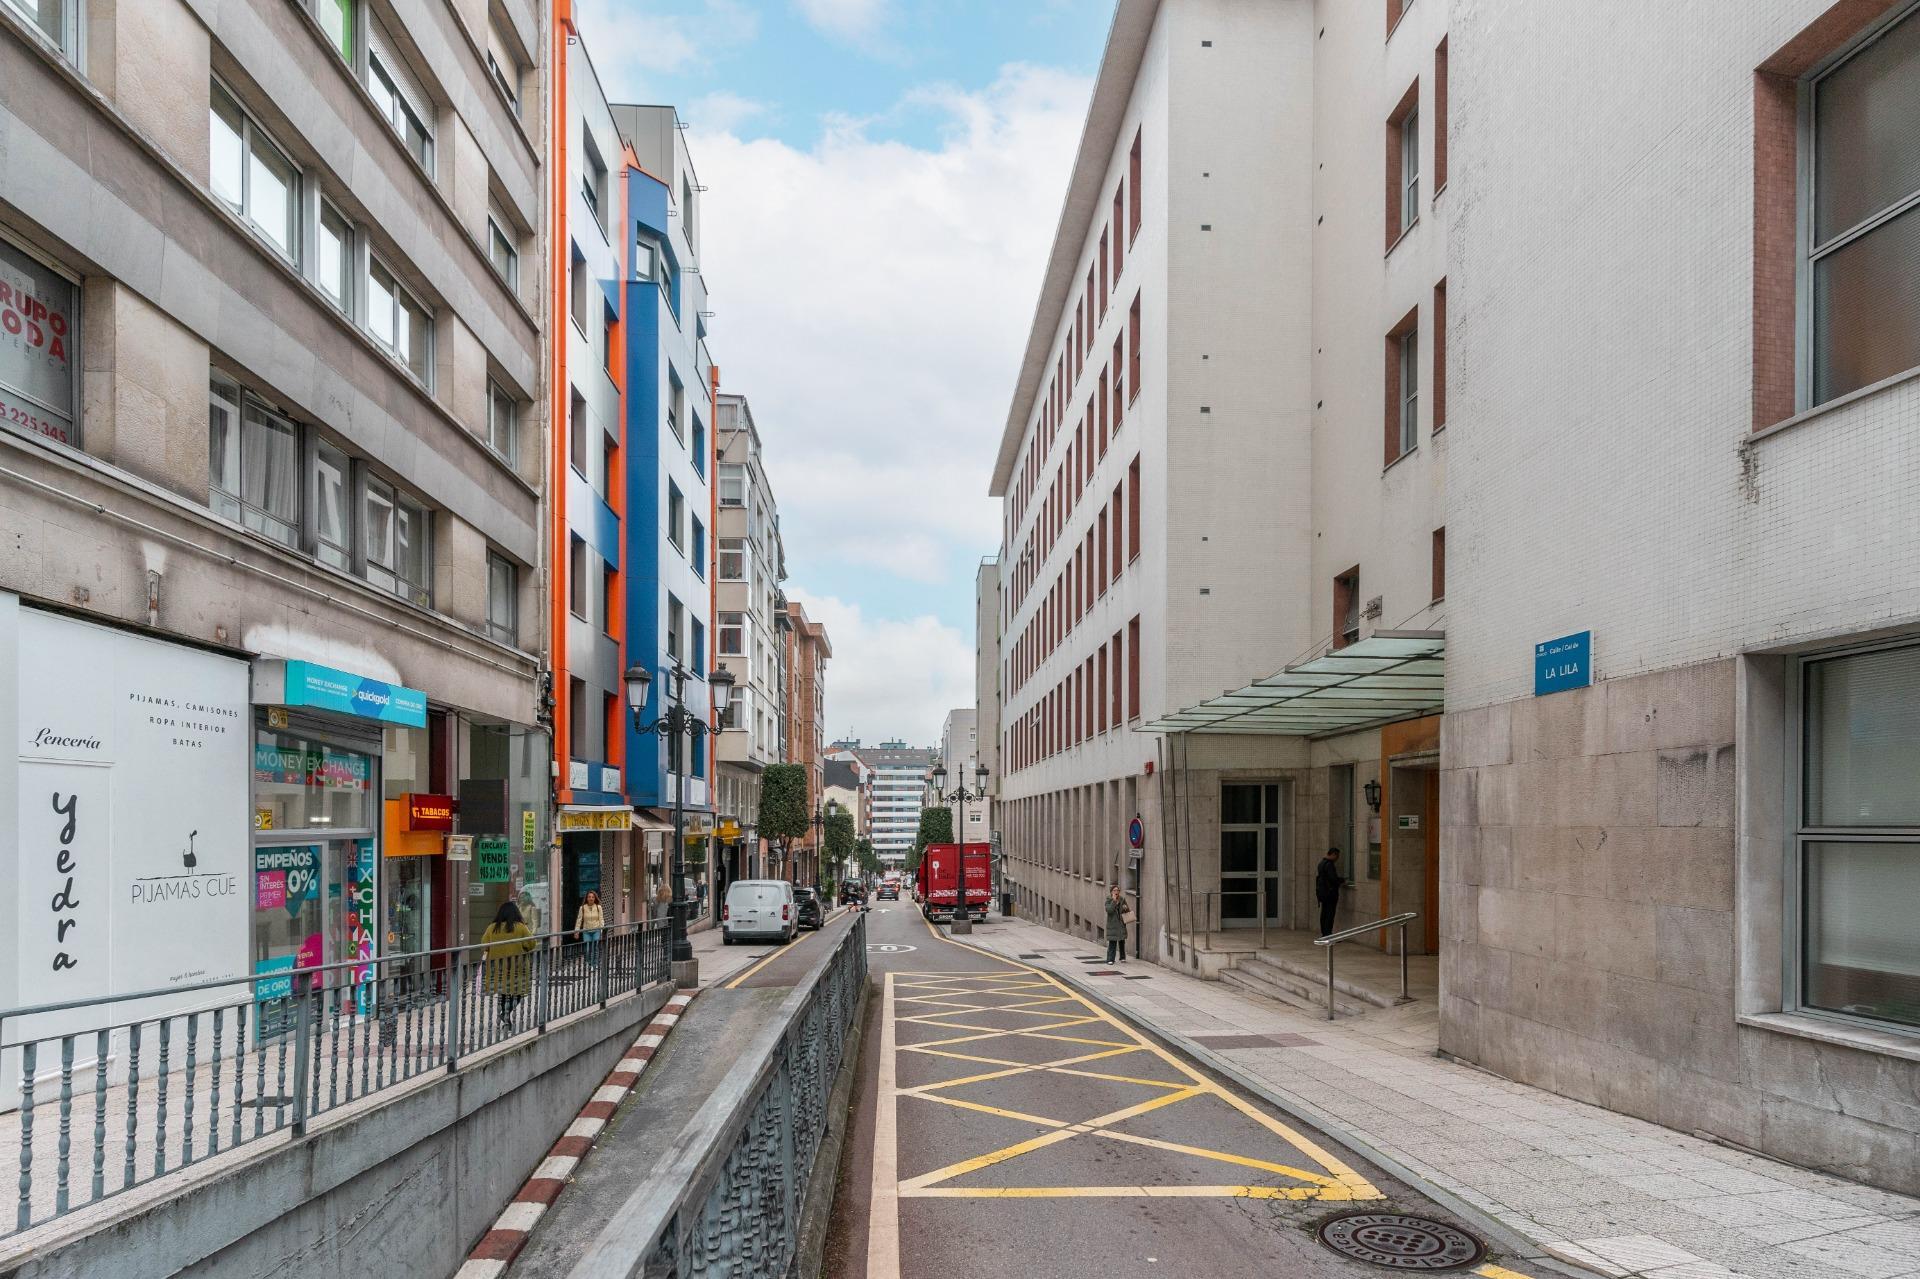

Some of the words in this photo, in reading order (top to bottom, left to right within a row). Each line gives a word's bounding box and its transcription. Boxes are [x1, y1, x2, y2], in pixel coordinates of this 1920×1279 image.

[11, 407, 38, 431] 225
[41, 421, 68, 444] 345
[1545, 667, 1556, 679] LA
[1559, 662, 1579, 677] LILA
[130, 693, 180, 708] PIJAMAS,
[185, 702, 239, 718] CAMISONES
[358, 690, 390, 705] quickgold
[149, 716, 175, 727] ROPA
[181, 720, 227, 734] INTERIOR
[28, 727, 101, 750] Lencería
[172, 738, 203, 748] BATAS
[256, 752, 303, 769] MONEY
[307, 757, 366, 776] EXCHANGE
[421, 807, 450, 816] TABACOS
[257, 850, 313, 869] EMPEÑOS
[481, 853, 508, 864] VENDE
[287, 869, 317, 893] 0%
[131, 880, 201, 904] PIJAMAS
[206, 877, 237, 897] CUE
[258, 983, 270, 996] DE
[271, 979, 290, 992] ORO
